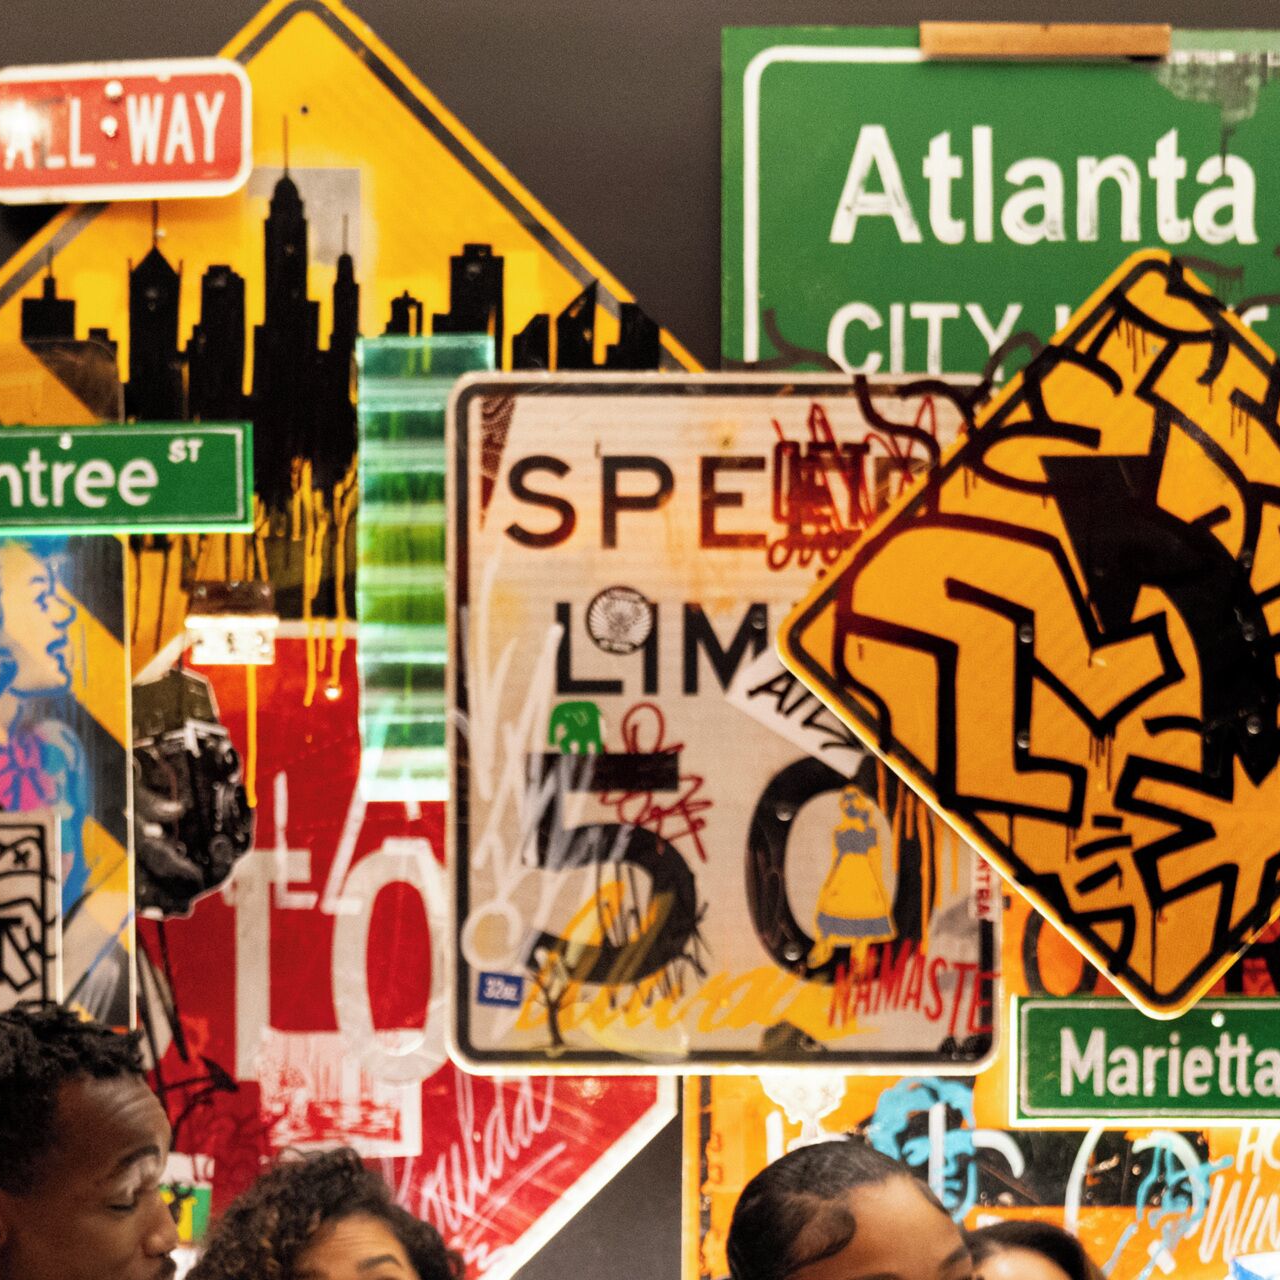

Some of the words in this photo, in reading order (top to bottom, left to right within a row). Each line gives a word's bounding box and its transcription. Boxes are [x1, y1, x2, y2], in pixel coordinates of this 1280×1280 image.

[126, 91, 225, 166] WAY
[828, 124, 1260, 245] Atlanta
[826, 302, 1023, 382] CITY
[168, 439, 204, 465] ST
[504, 455, 932, 550] SPE
[555, 602, 770, 696] LIM
[526, 754, 937, 987] 50
[828, 938, 1000, 1036] NAMASTE
